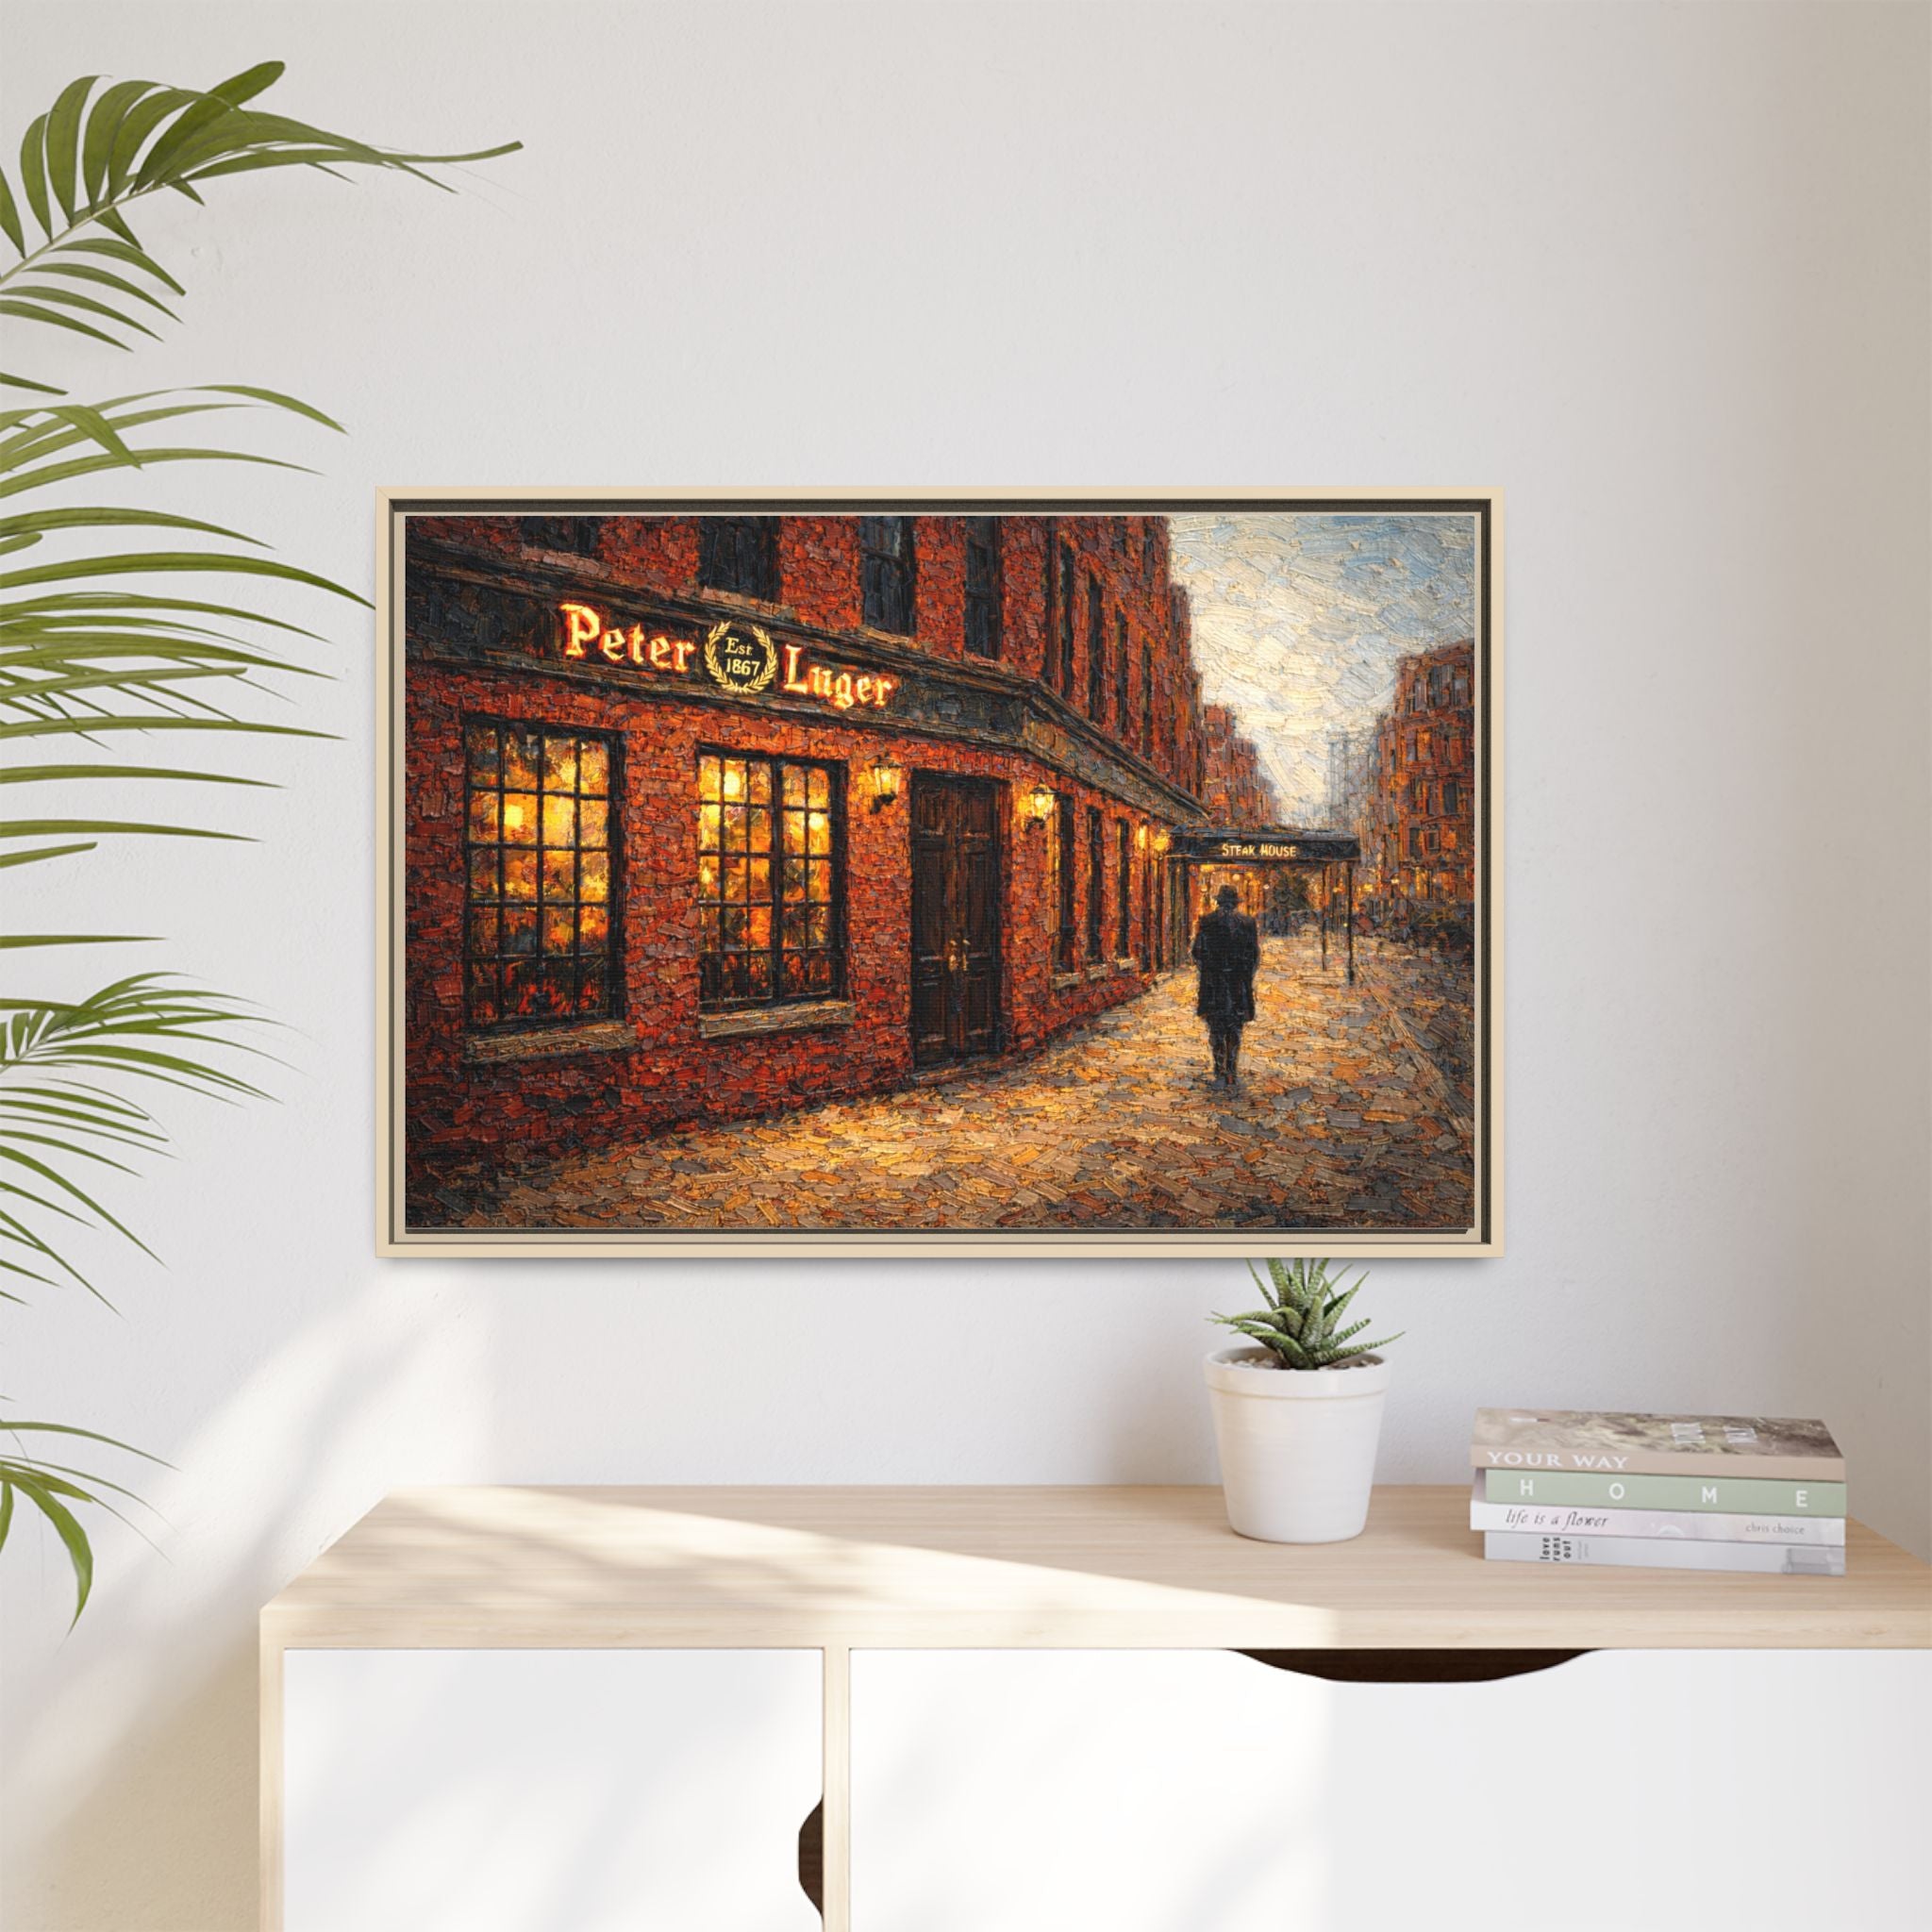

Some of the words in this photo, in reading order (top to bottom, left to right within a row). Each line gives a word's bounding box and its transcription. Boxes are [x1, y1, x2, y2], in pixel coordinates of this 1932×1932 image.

[560, 603, 696, 675] Peter
[782, 642, 892, 710] Luger
[726, 658, 760, 676] 1867
[1222, 842, 1256, 857] STEAK
[1487, 1451, 1563, 1467] YOUR
[1573, 1455, 1629, 1469] WAY
[1506, 1508, 1528, 1528] life
[1534, 1512, 1546, 1525] is
[1550, 1516, 1558, 1525] a
[1562, 1510, 1608, 1531] flower
[1745, 1521, 1770, 1533] chris
[1539, 1537, 1550, 1559] love
[1562, 1541, 1572, 1558] out
